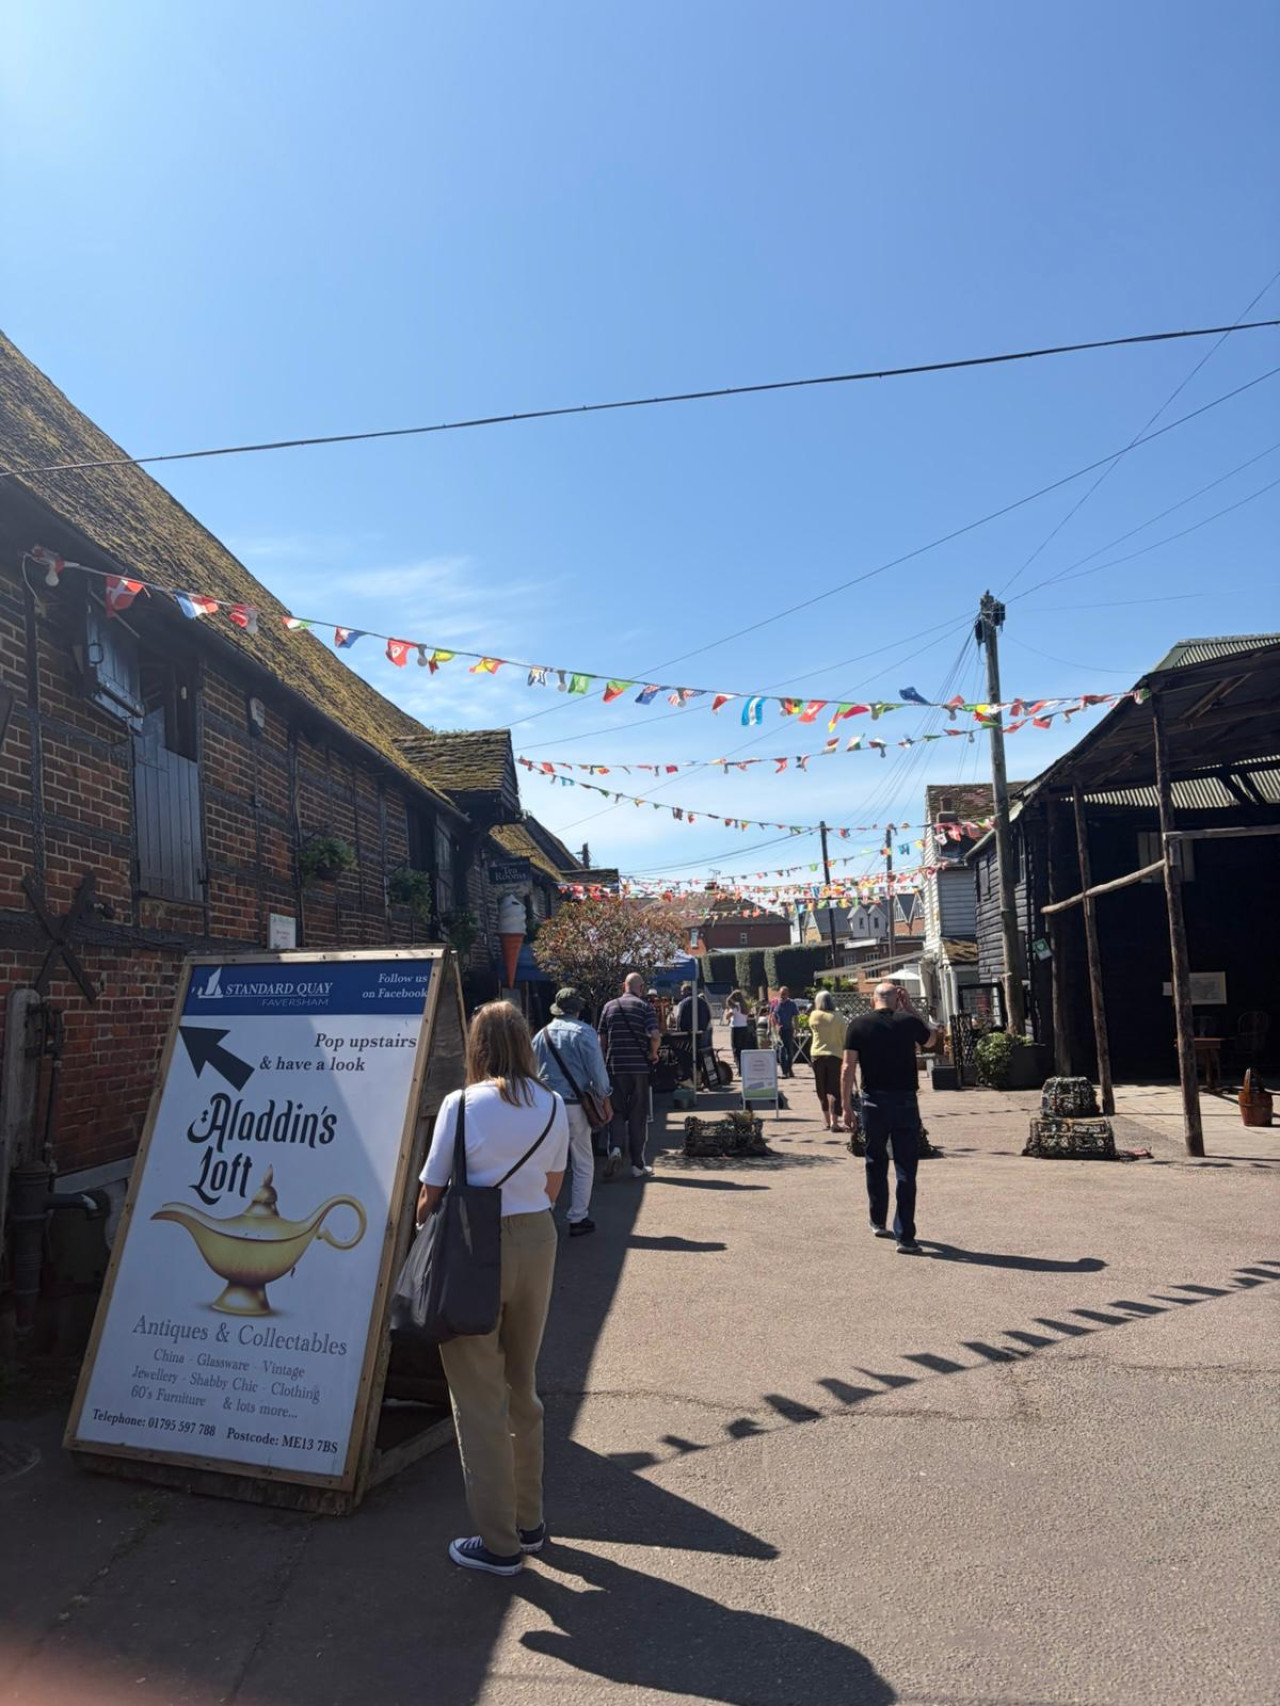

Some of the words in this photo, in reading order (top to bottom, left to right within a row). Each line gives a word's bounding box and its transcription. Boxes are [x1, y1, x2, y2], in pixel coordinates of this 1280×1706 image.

[224, 983, 294, 995] STANDARD
[296, 982, 333, 997] QUAY
[362, 990, 376, 998] on
[377, 988, 428, 998] Facebook
[377, 973, 413, 983] Follow
[415, 974, 428, 983] us
[261, 998, 329, 1007] FAVERSHAM
[315, 1033, 344, 1051] Pop
[349, 1033, 417, 1051] upstairs
[259, 1056, 271, 1070] &
[275, 1057, 312, 1071] have
[316, 1061, 325, 1071] a
[330, 1057, 366, 1072] look
[187, 1092, 338, 1153] Aladdin's
[188, 1145, 253, 1206] Loft
[132, 1315, 209, 1344] Antiques
[215, 1322, 231, 1343] &
[238, 1324, 348, 1356] Collectables
[153, 1347, 185, 1364] China
[196, 1353, 250, 1371] Glassware
[263, 1360, 305, 1381] Vintage
[131, 1365, 178, 1384] Jewellery
[189, 1371, 228, 1391] Shabby
[232, 1377, 259, 1393] Chic
[271, 1381, 320, 1405] Clothing
[131, 1384, 153, 1400] 60's
[156, 1387, 207, 1407] Furniture
[222, 1396, 233, 1410] &
[236, 1398, 256, 1414] lots
[259, 1404, 298, 1419] more...
[93, 1408, 146, 1427] Telephone:
[147, 1417, 177, 1431] 01795
[177, 1421, 196, 1434] 597
[198, 1423, 217, 1437] 788
[226, 1427, 279, 1446] Postcode:
[281, 1434, 314, 1451] ME13
[316, 1439, 339, 1454] 7BS
